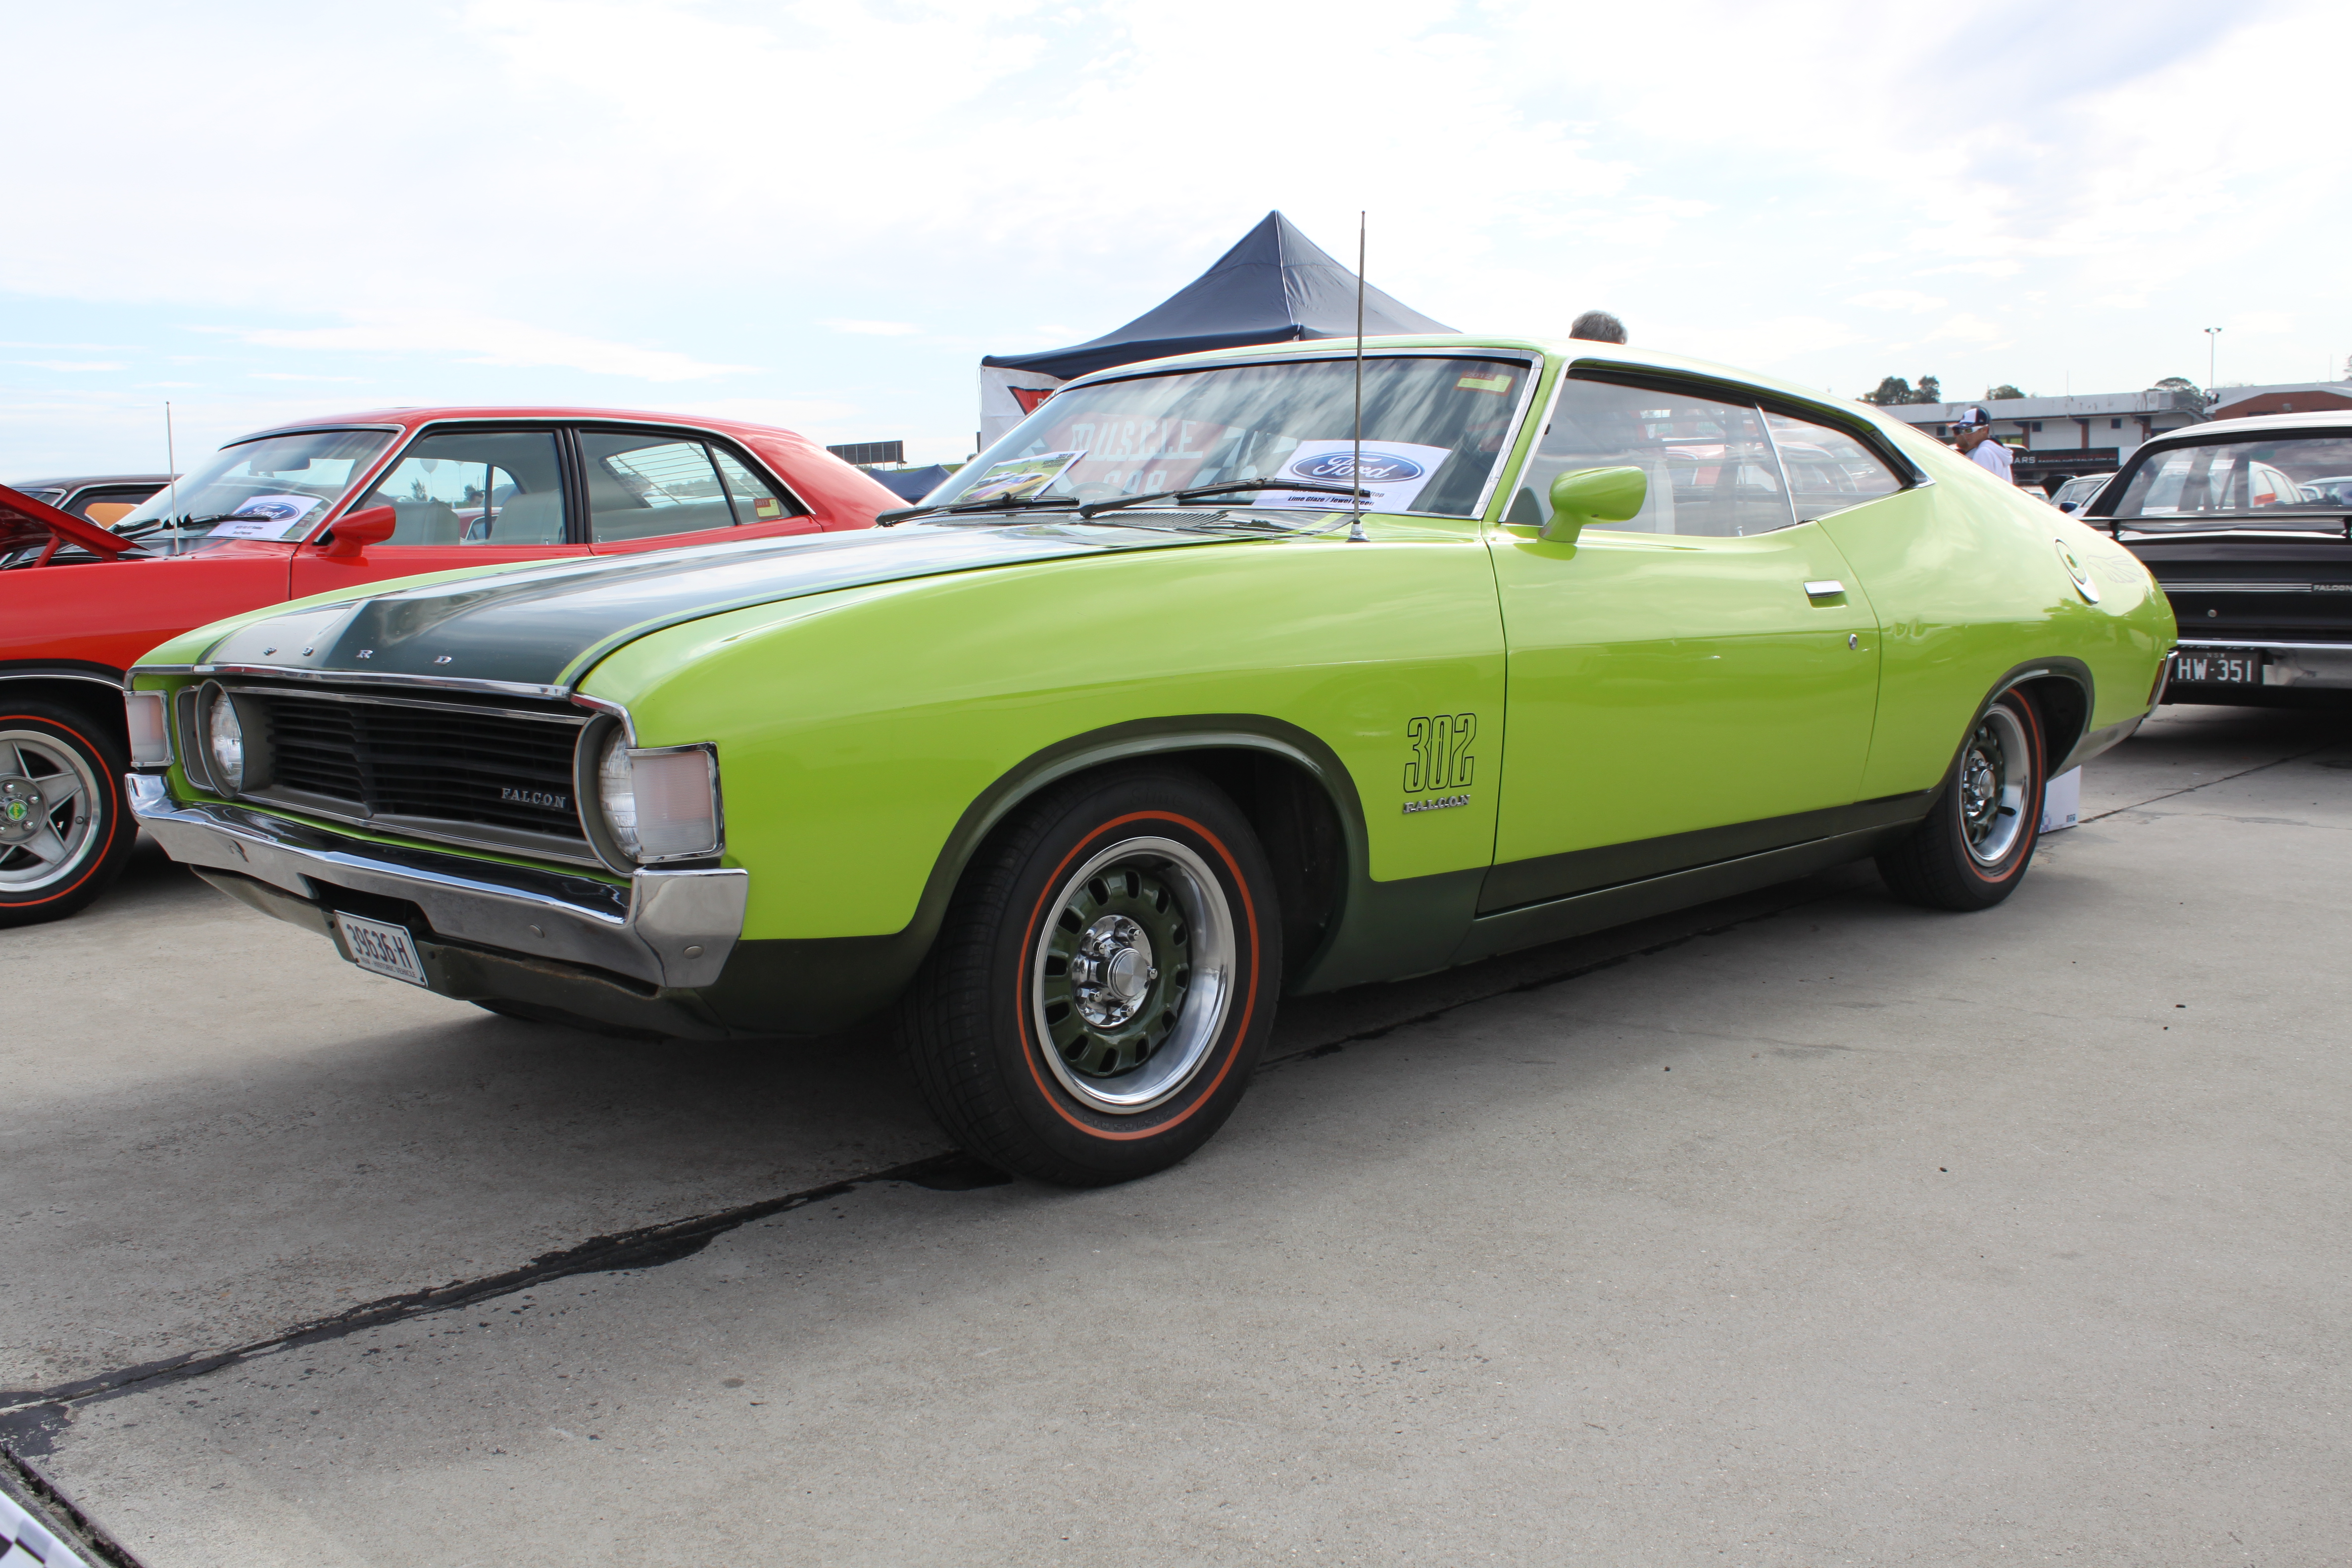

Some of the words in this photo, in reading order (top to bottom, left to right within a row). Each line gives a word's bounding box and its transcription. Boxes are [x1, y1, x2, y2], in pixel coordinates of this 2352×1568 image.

[1068, 419, 1203, 461] MUSCLE
[1312, 456, 1399, 479] Ford
[247, 505, 288, 519] Ford
[1403, 713, 1476, 793] 302
[501, 787, 566, 808] FALCON
[1403, 794, 1470, 814] FALCON
[347, 924, 413, 969] 39636-H
[395, 967, 417, 978] VEHICLE
